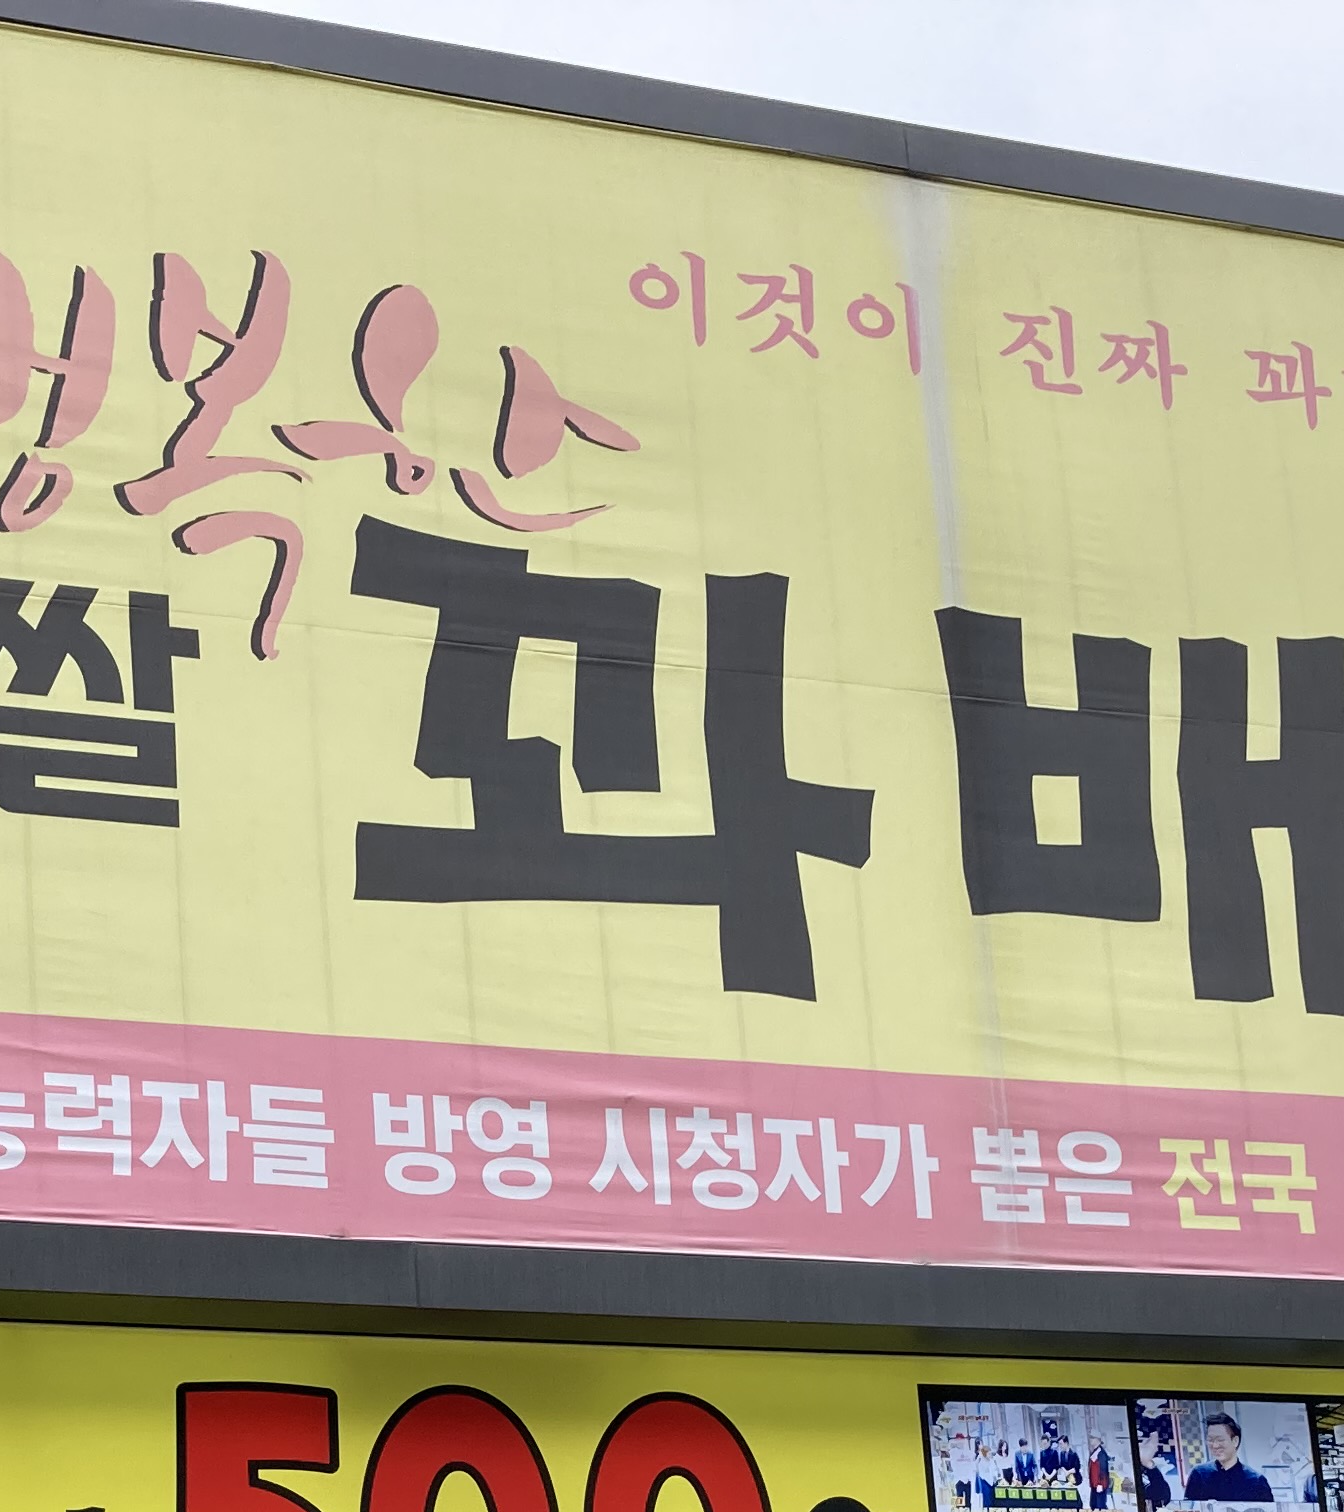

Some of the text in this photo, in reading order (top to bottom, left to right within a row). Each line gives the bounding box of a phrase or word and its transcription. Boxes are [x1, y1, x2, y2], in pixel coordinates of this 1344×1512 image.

[628, 251, 921, 375] 이것이
[999, 305, 1188, 409] 진짜
[372, 1092, 551, 1200] 방영
[588, 1106, 939, 1219] 시청자가
[968, 1125, 1133, 1227] 뽑은
[1157, 1136, 1318, 1235] 전국
